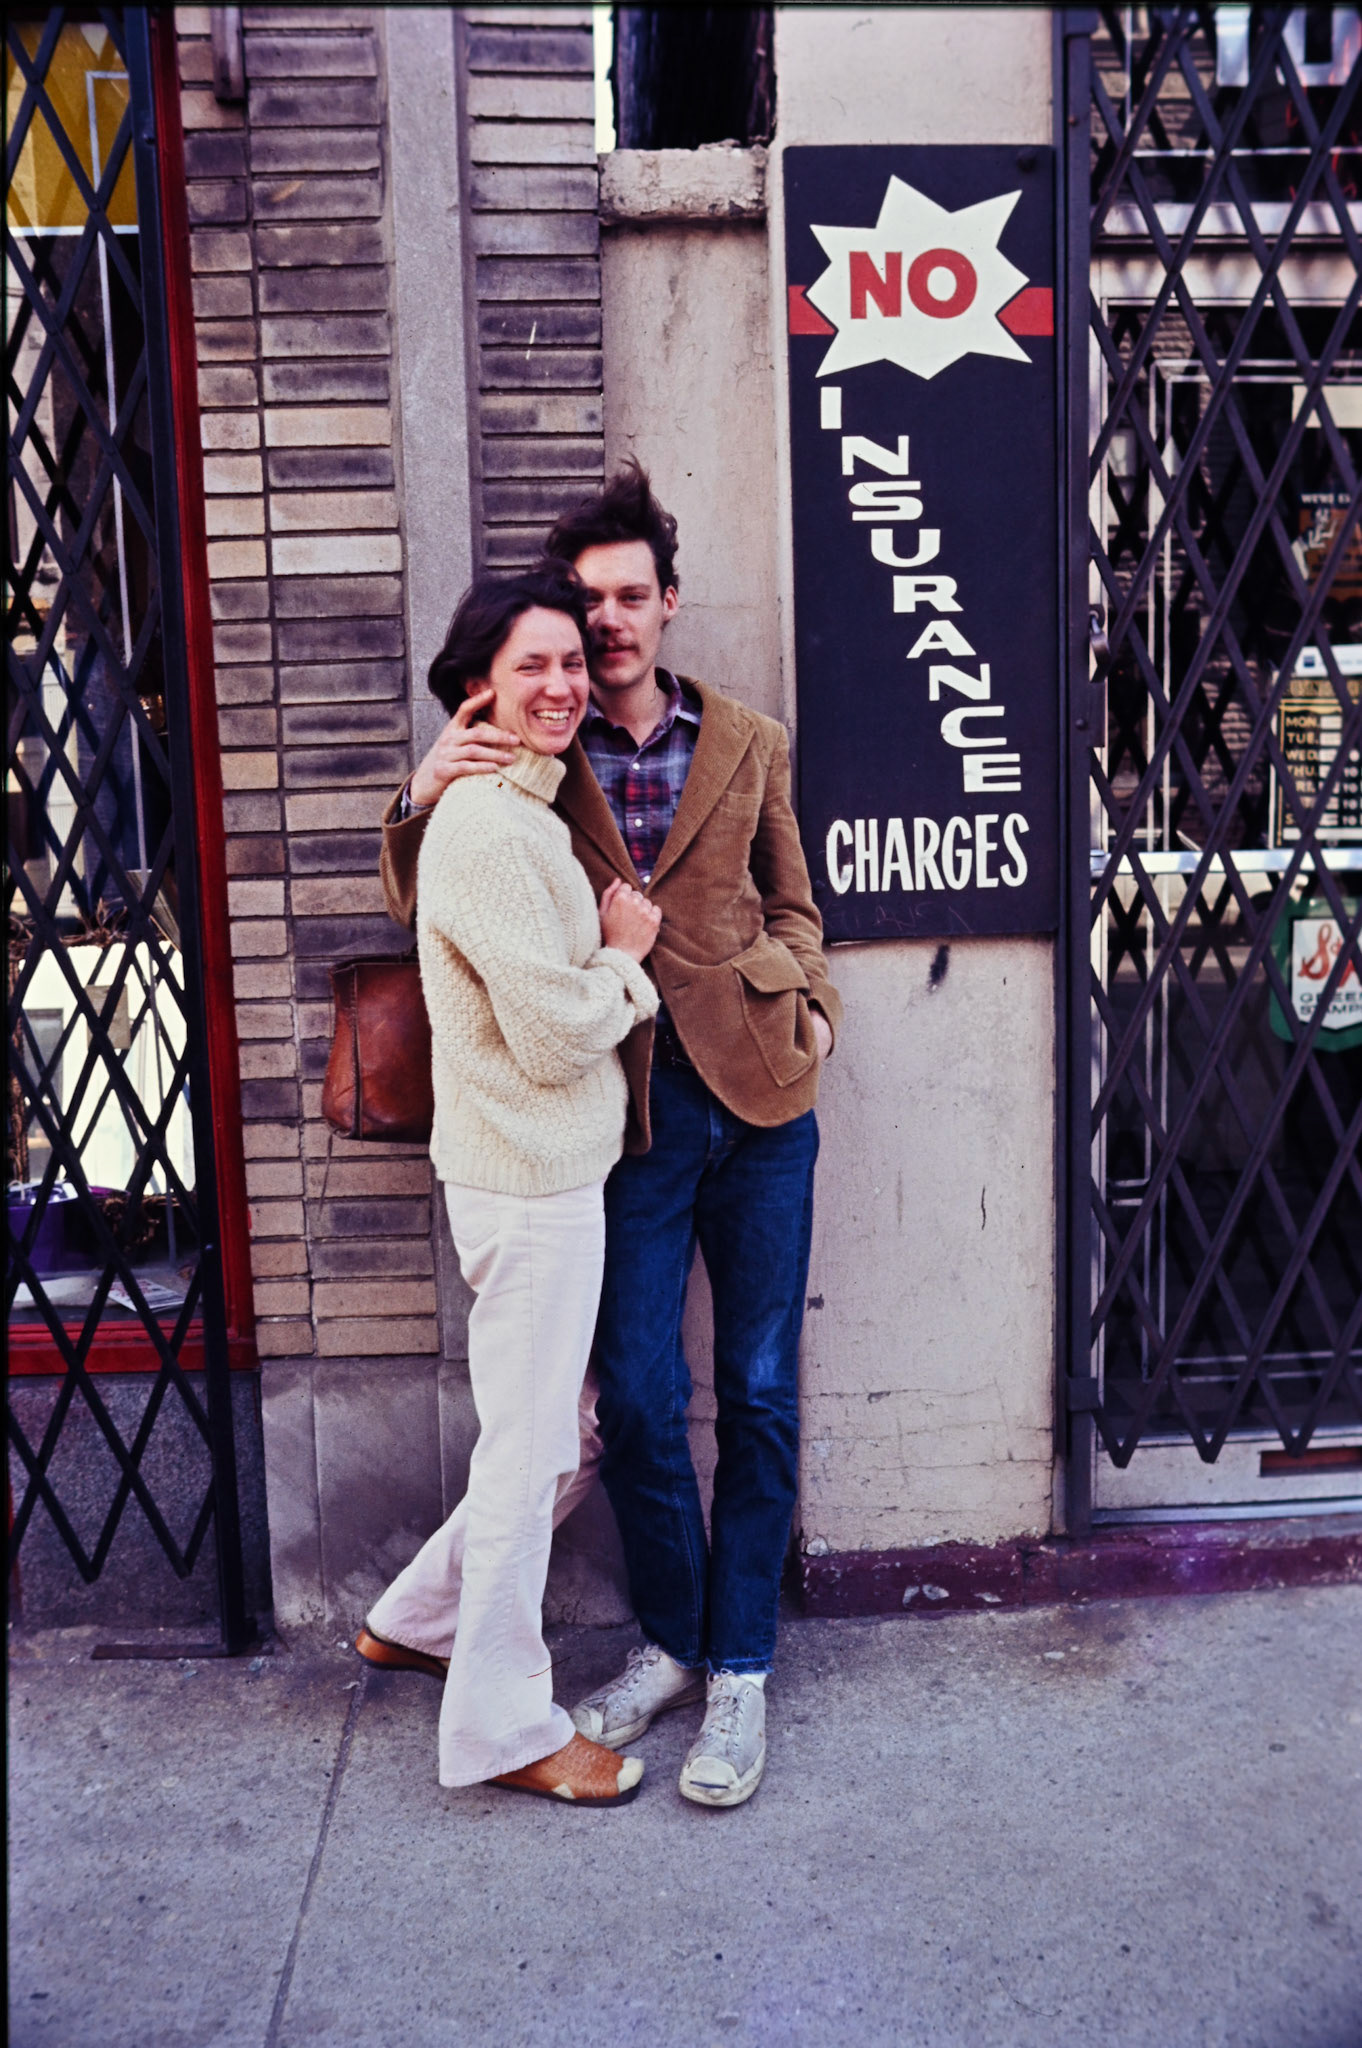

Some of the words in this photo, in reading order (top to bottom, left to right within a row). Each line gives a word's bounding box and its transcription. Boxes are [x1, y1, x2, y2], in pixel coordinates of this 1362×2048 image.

[849, 248, 977, 319] NO
[820, 386, 1022, 793] INSURANCE
[826, 813, 1029, 894] CHARGES
